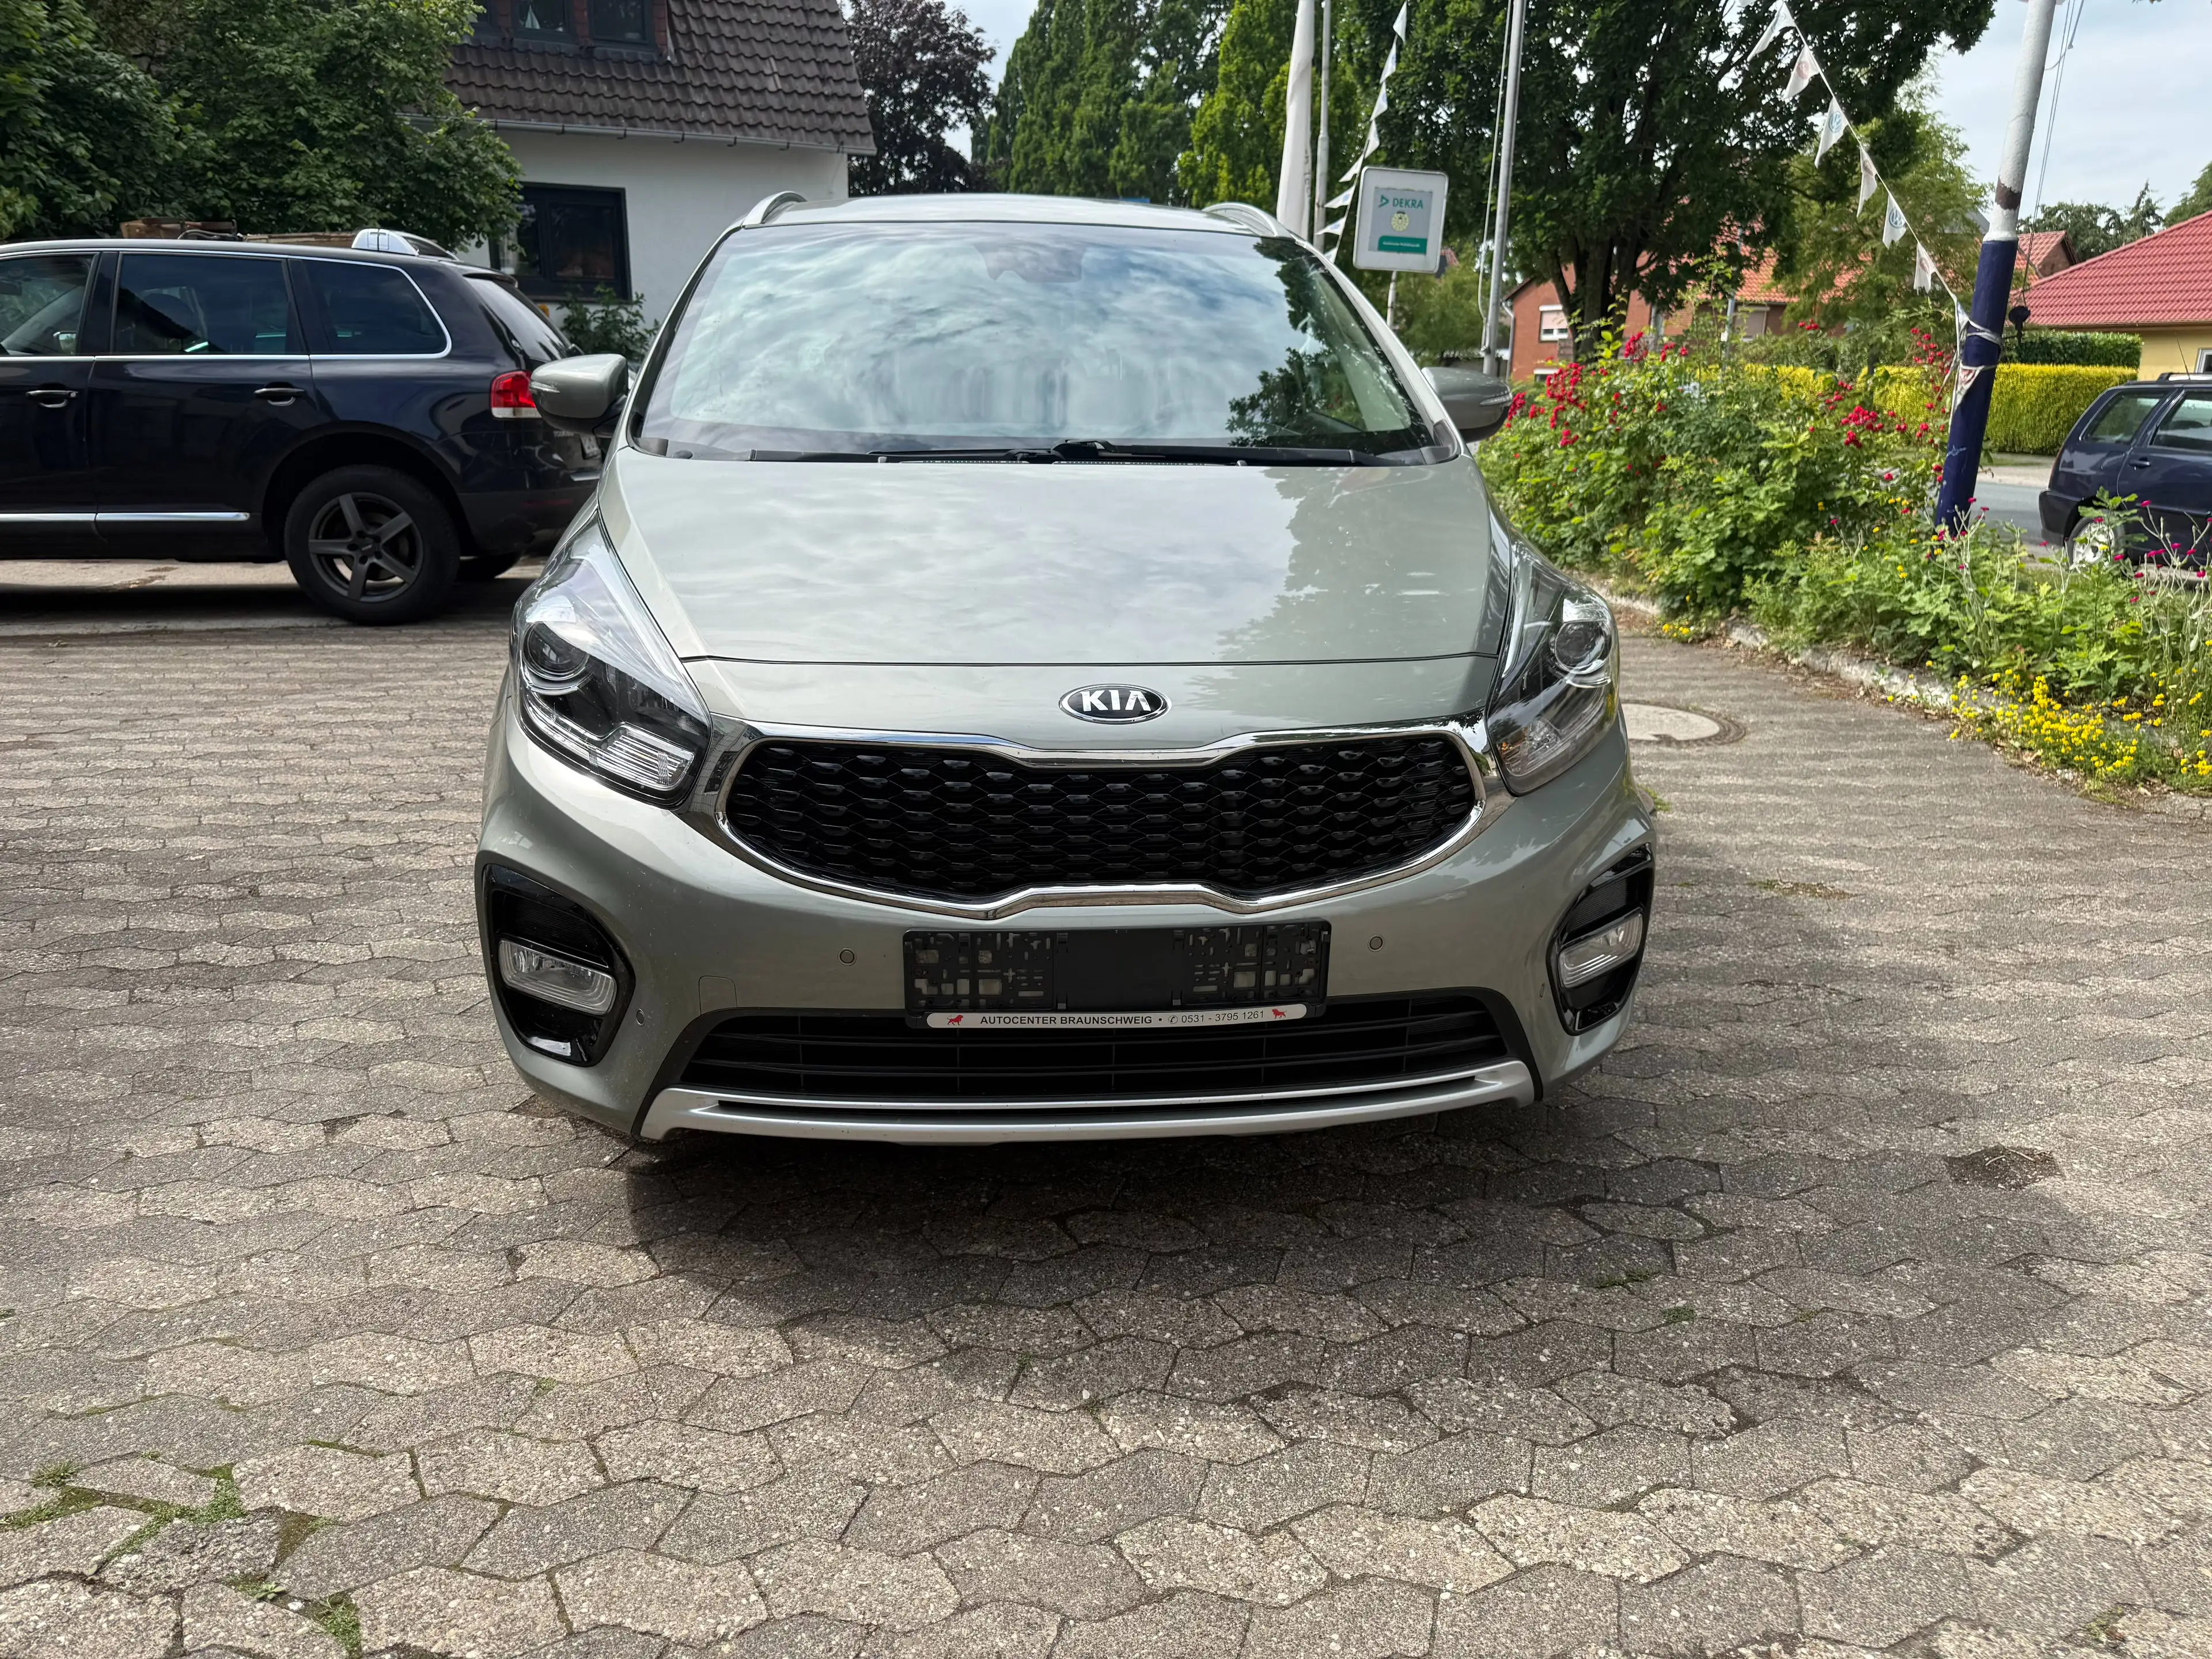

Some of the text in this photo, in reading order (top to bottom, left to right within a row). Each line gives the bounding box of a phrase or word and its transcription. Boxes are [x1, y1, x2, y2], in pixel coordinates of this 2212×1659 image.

[1392, 198, 1423, 209] DEKRA
[1080, 690, 1152, 712] KIA
[980, 1016, 1056, 1024] AUTOCENTER
[1060, 1016, 1152, 1024] BRAUNSCHWEIG
[1181, 1014, 1205, 1023] 0531
[1215, 1012, 1238, 1021] 3795
[1243, 1010, 1264, 1020] 1261
